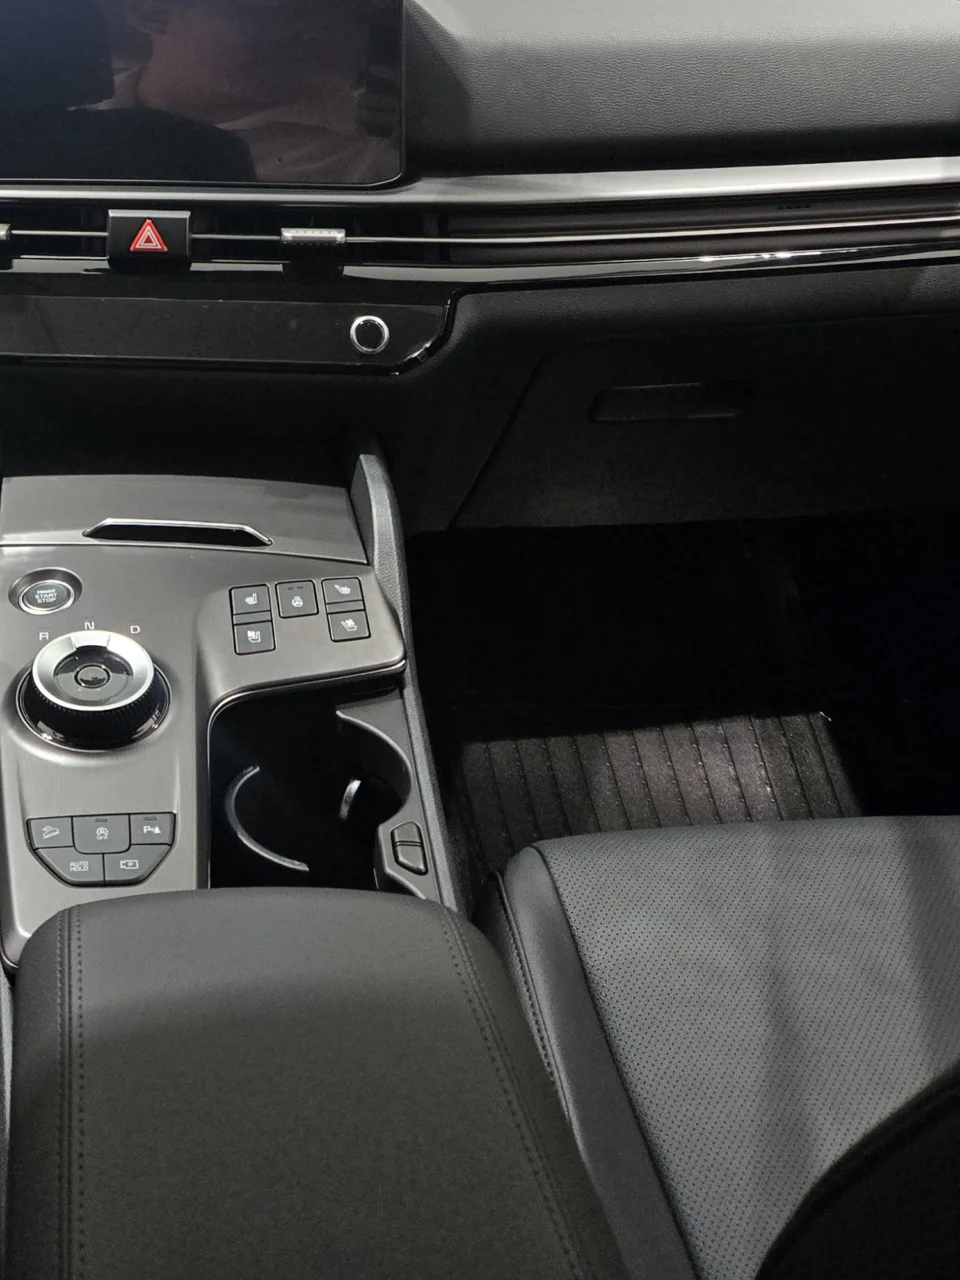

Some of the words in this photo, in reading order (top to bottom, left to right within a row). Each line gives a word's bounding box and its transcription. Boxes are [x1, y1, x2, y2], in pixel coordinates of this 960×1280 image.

[39, 631, 49, 641] R
[84, 621, 95, 630] N
[129, 625, 141, 634] D
